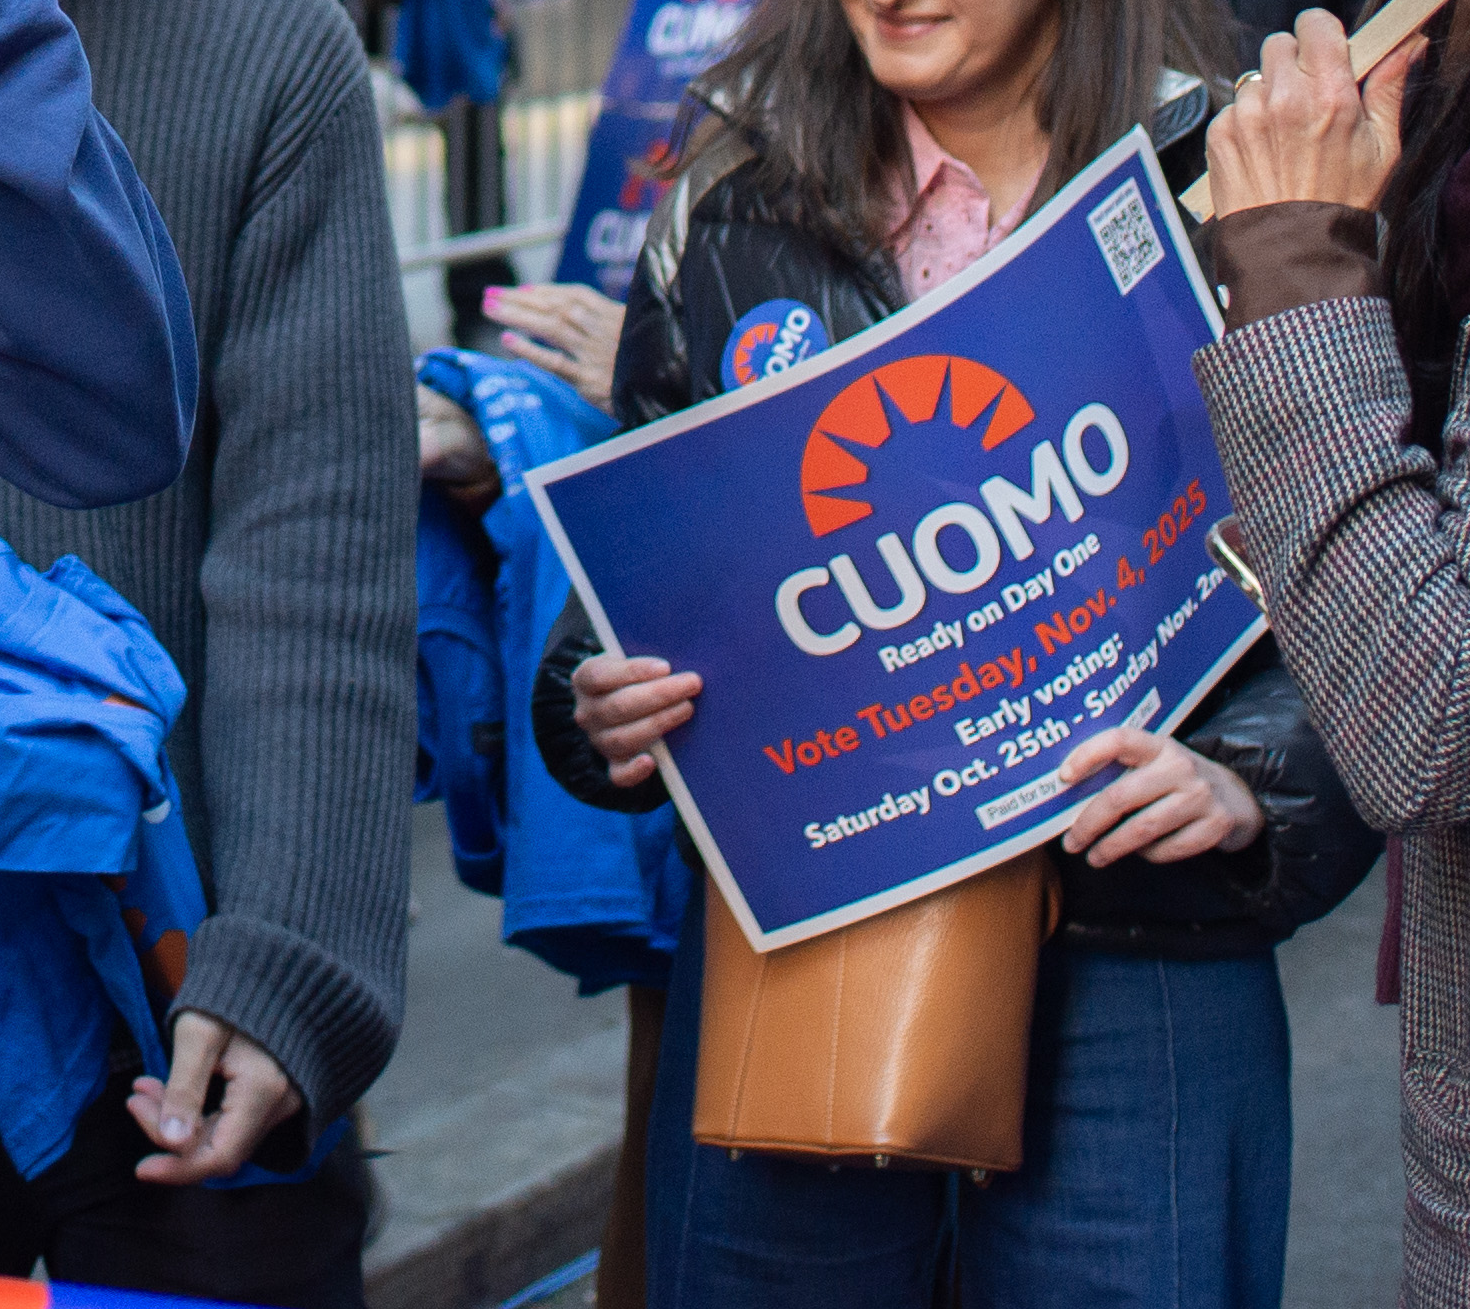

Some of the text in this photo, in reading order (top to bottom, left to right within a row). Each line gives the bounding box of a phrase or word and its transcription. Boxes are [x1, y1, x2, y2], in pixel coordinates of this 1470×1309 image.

[759, 308, 812, 379] OMO
[763, 479, 1207, 774] Vote Tuesday, Nov. 4, 2025
[776, 404, 1129, 656] CUOMO
[879, 535, 1100, 672] Ready on Day One
[805, 787, 930, 848] Saturday
[934, 759, 999, 796] Oct.
[998, 718, 1071, 768] 25th
[1085, 639, 1158, 719] Sunday
[1157, 598, 1199, 646] Nov.
[1197, 567, 1227, 601] 2n
[955, 633, 1123, 746] Early voting:
